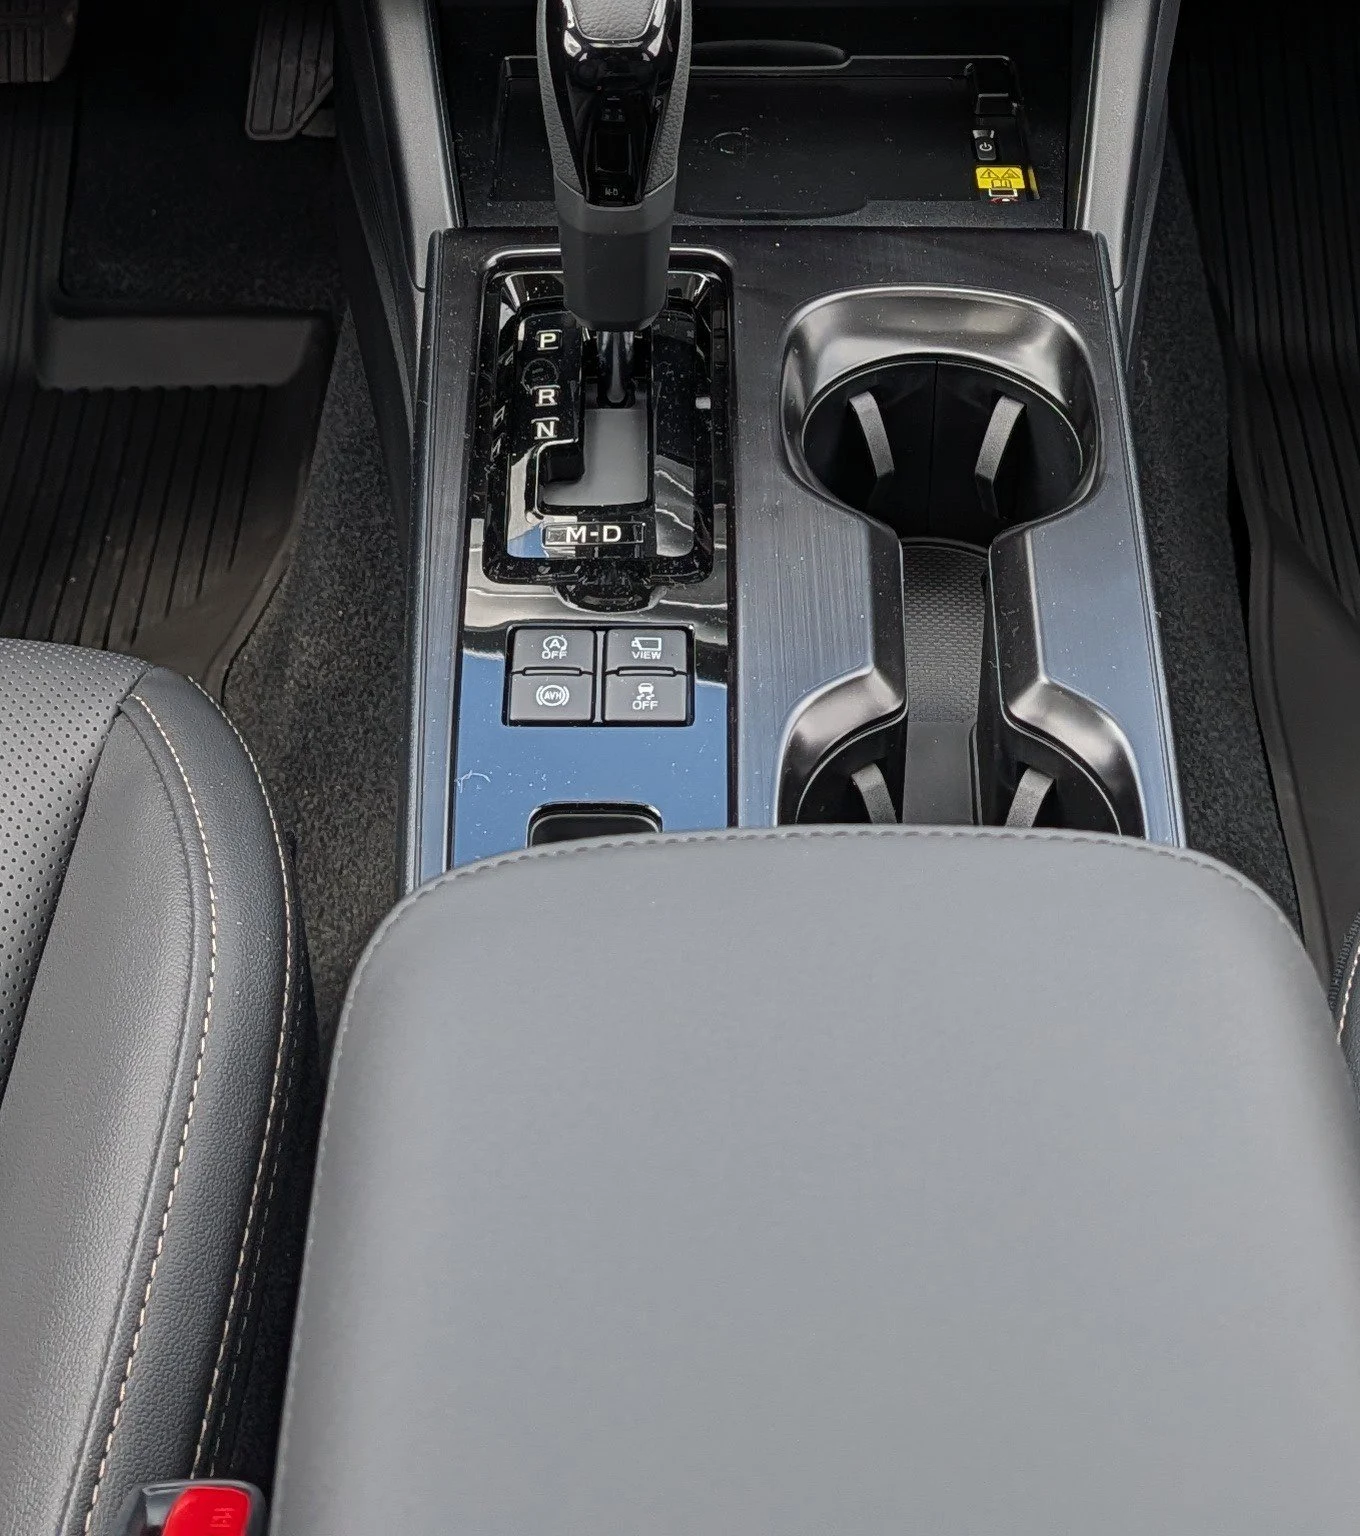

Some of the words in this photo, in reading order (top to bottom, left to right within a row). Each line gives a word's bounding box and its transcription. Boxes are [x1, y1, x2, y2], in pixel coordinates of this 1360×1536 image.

[540, 333, 556, 347] P
[538, 389, 557, 404] R
[536, 421, 555, 437] N
[565, 525, 622, 542] M-D
[542, 651, 568, 659] OFF
[544, 690, 561, 700] AVH
[632, 701, 658, 710] OFF
